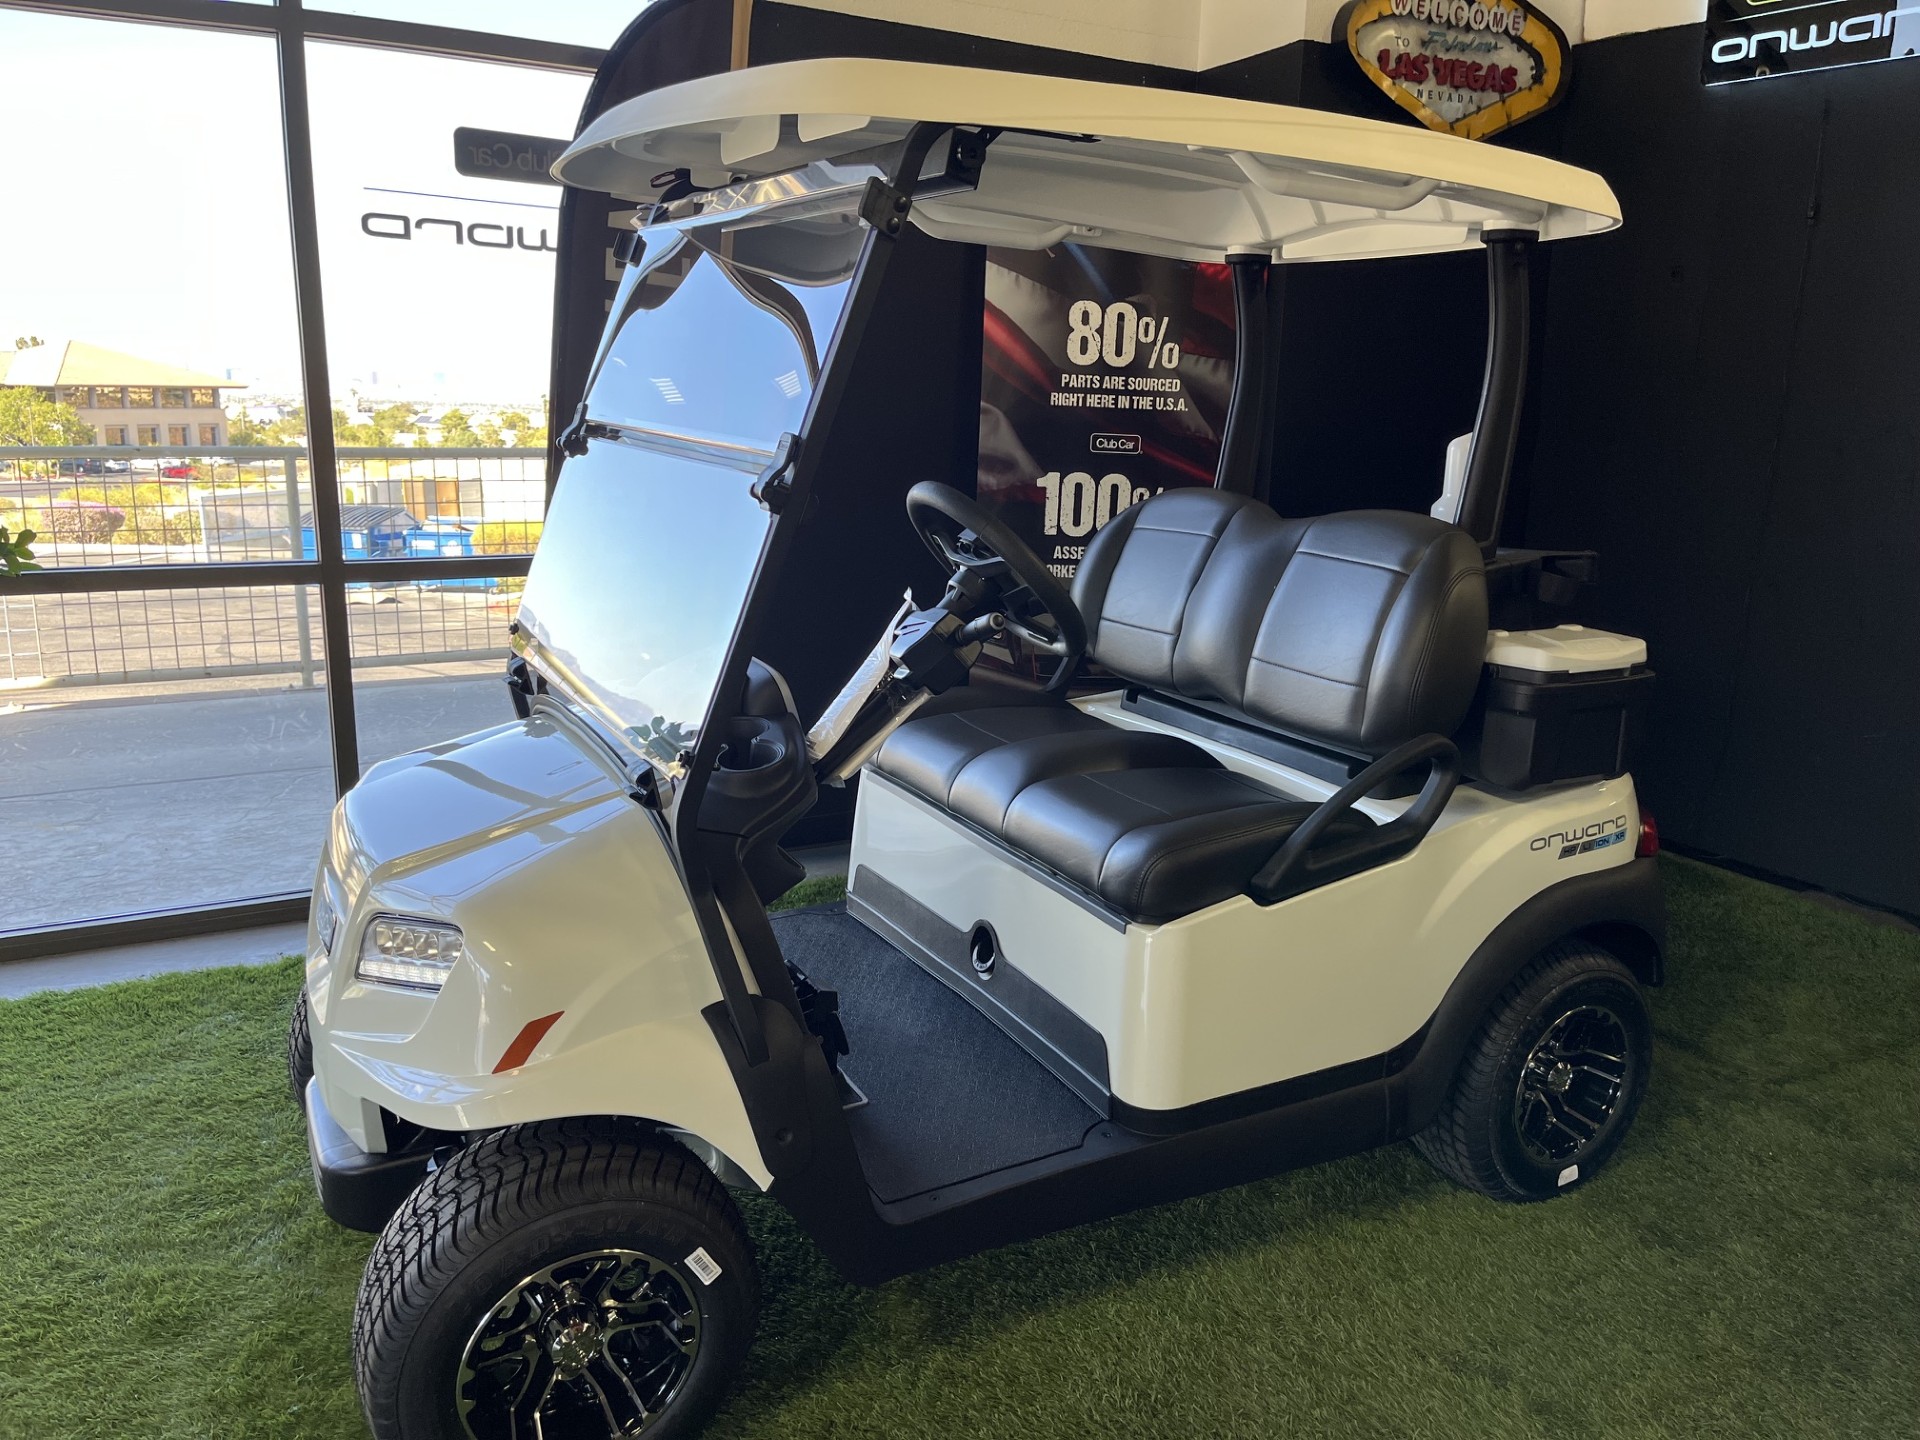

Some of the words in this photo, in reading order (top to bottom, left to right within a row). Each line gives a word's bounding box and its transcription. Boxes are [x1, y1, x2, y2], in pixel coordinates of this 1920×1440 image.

[1393, 0, 1522, 32] WELCOME
[1394, 36, 1410, 48] TO
[1711, 6, 1920, 63] onwar
[1377, 49, 1430, 83] LAS
[1432, 56, 1518, 94] VEGAS
[1416, 88, 1474, 105] NEVADA
[1066, 300, 1180, 369] 80%
[1061, 374, 1100, 389] PARTS
[1102, 375, 1126, 390] ARE
[1127, 377, 1181, 392] SOURCED
[1050, 392, 1084, 407] RIGHT
[1086, 394, 1116, 408] HERE
[1117, 395, 1131, 409] IN
[1132, 396, 1154, 410] THE
[1155, 397, 1188, 412] U.S.A.
[1096, 438, 1118, 449] Club
[1118, 439, 1135, 450] Car
[1036, 471, 1164, 538] 100
[1053, 545, 1087, 560] ASSE
